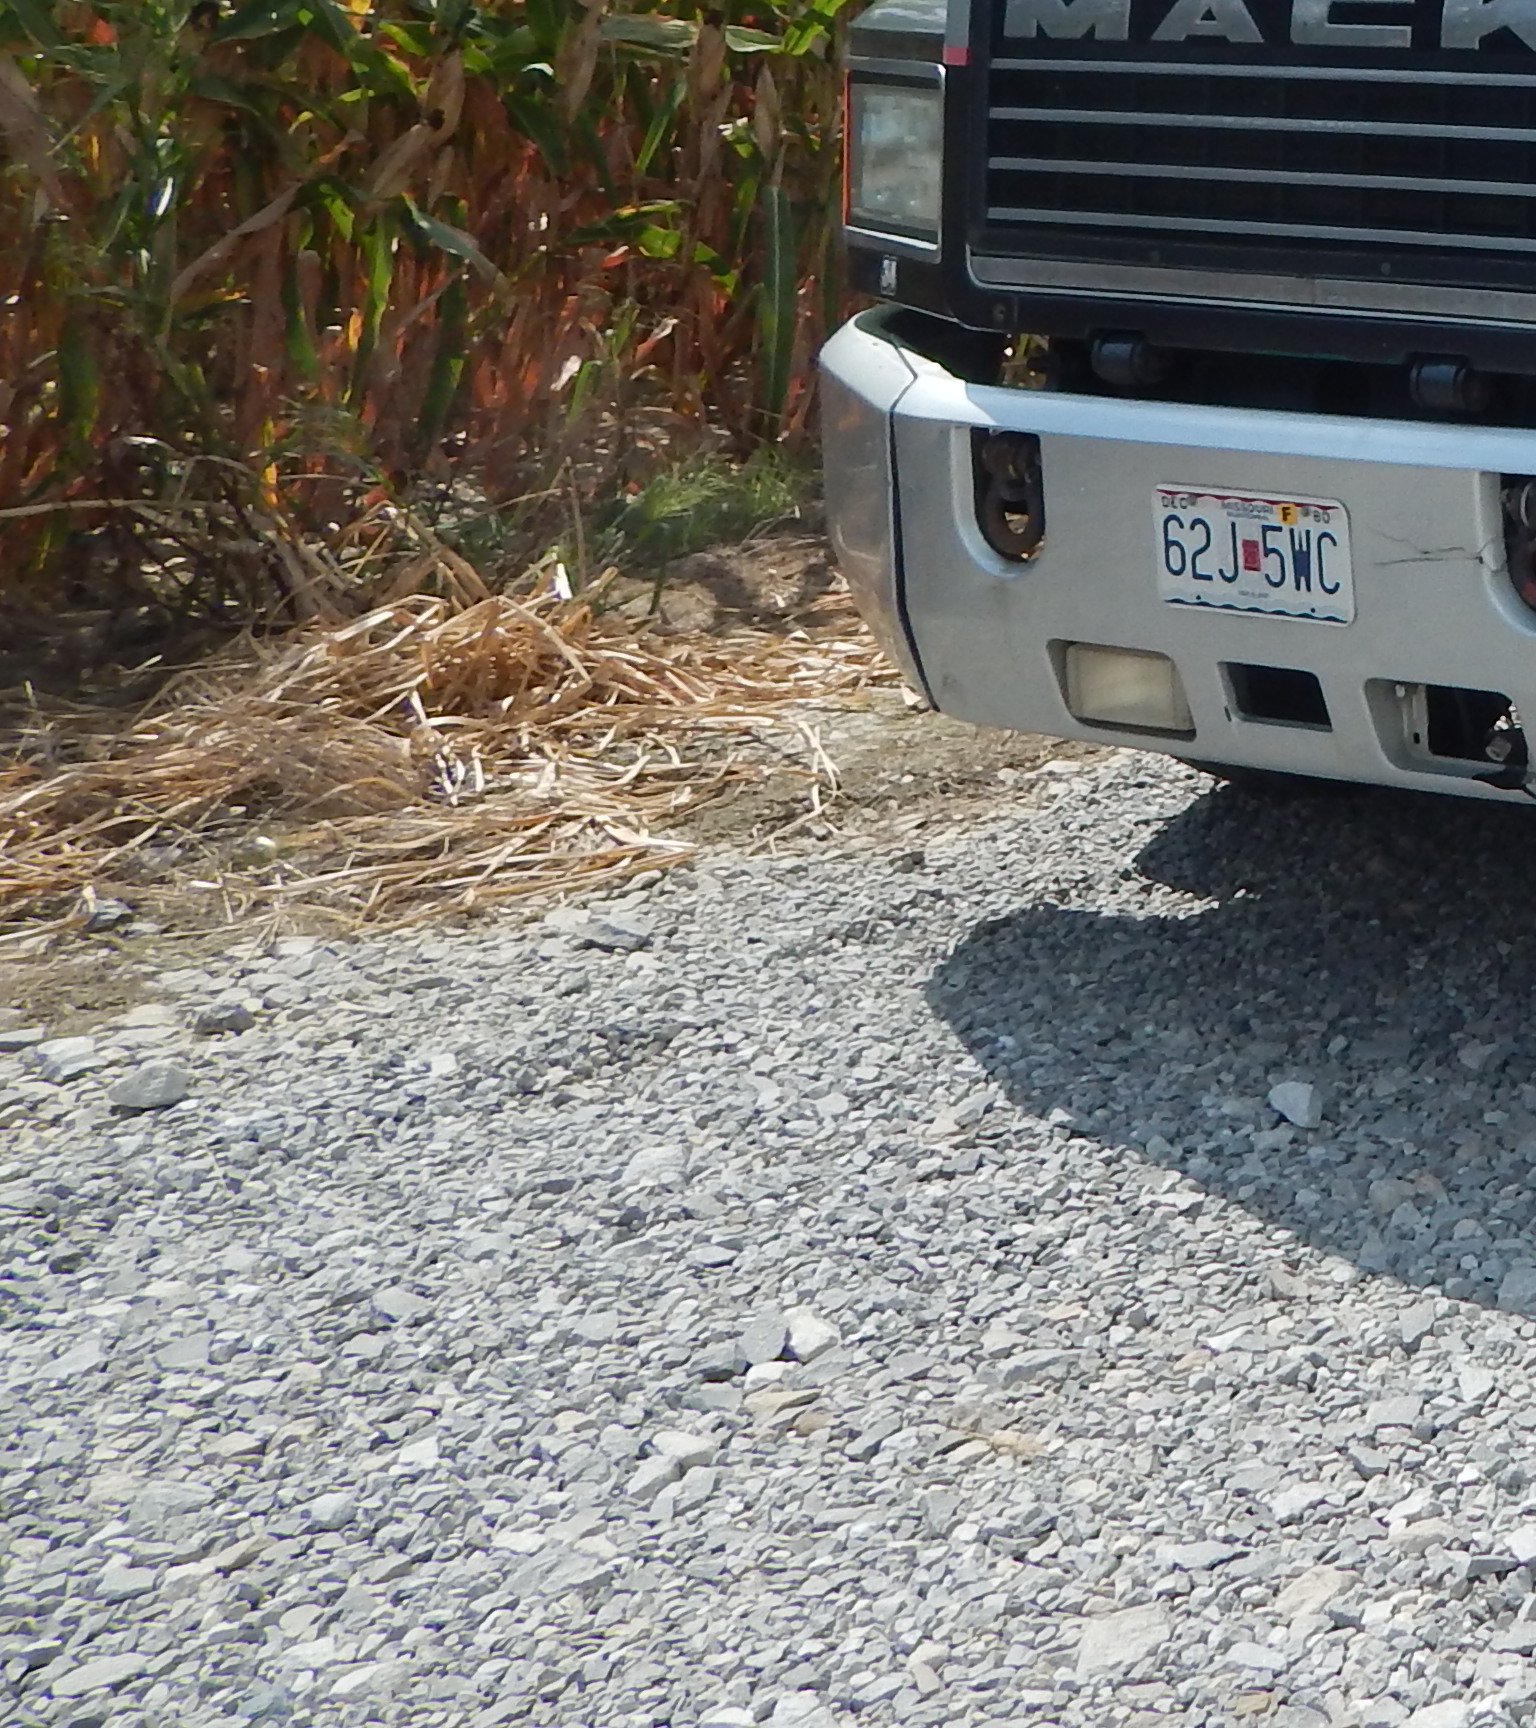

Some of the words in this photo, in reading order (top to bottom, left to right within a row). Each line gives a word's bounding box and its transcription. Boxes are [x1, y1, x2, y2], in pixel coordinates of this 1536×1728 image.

[1281, 506, 1291, 522] F
[1163, 514, 1239, 583] 62J
[1261, 524, 1340, 595] 5WC
